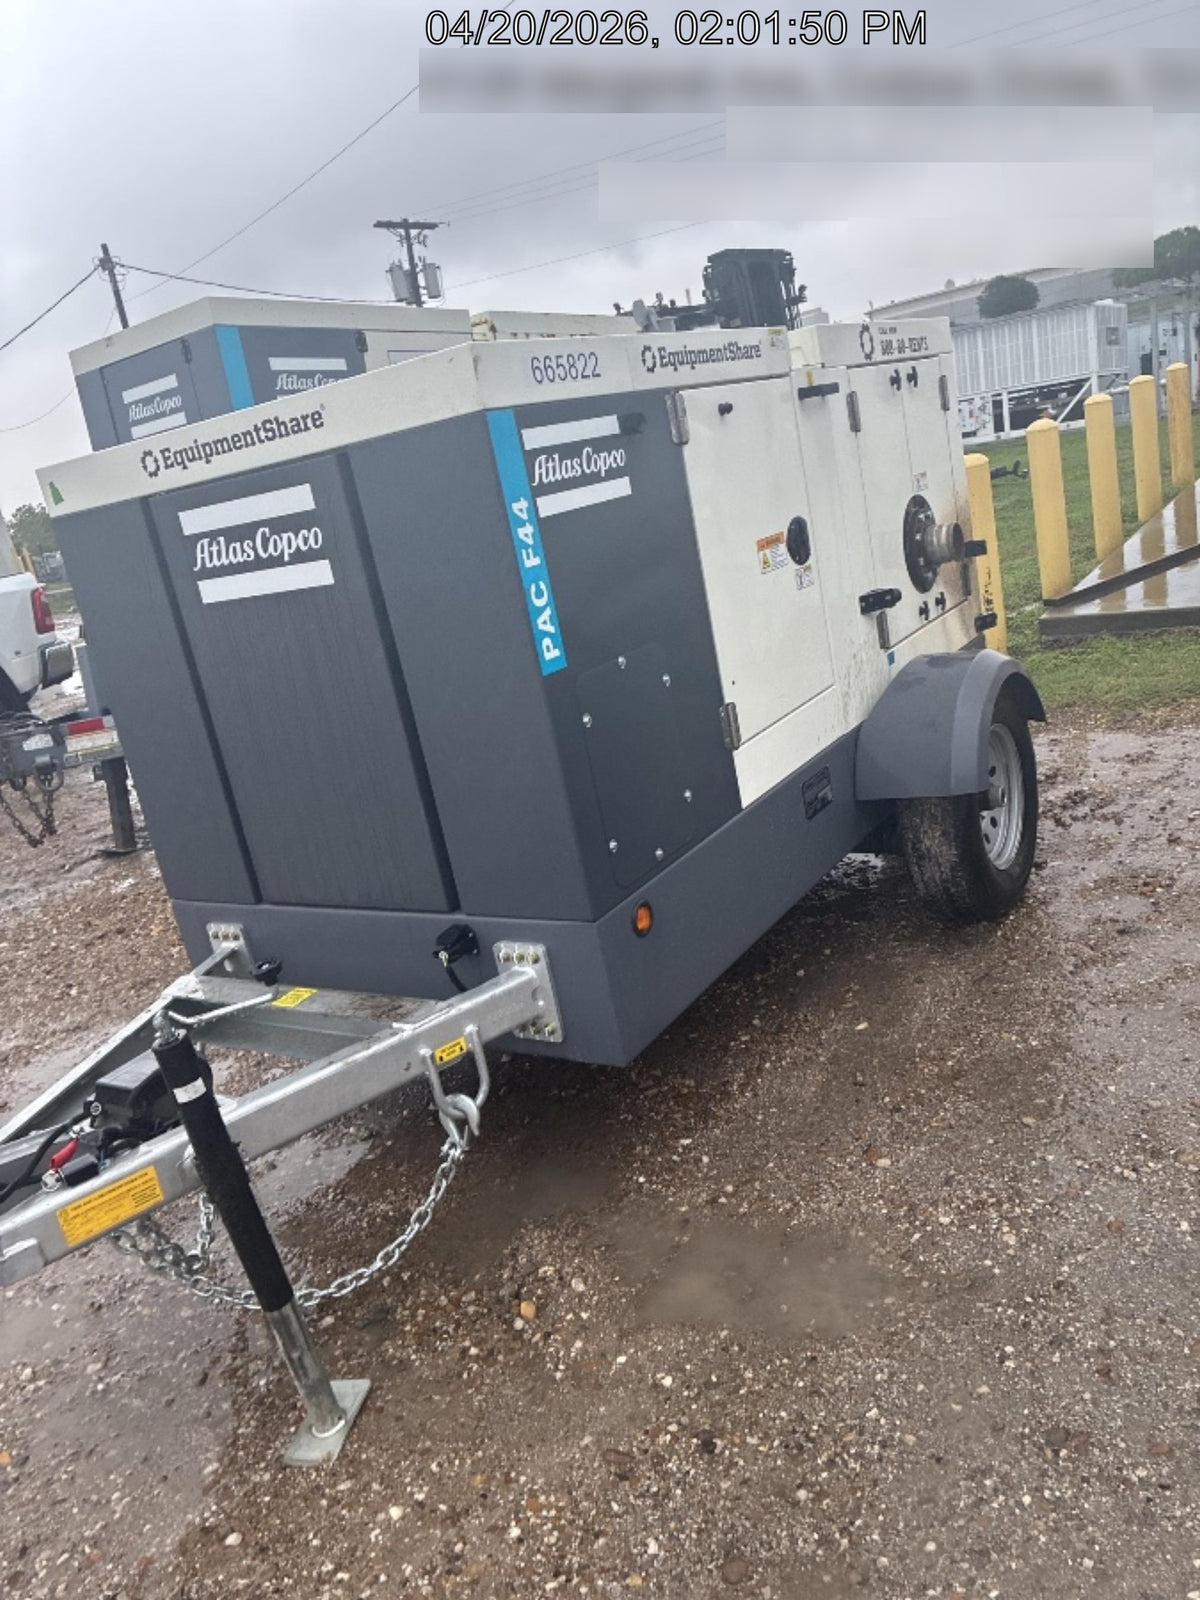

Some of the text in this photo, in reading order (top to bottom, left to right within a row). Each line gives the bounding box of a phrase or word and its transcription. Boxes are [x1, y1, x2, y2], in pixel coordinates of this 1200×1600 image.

[531, 352, 601, 384] 665822
[659, 341, 762, 372] EquipmentShare
[275, 373, 314, 391] Atlas
[128, 394, 183, 423] Atlas Copco
[160, 408, 325, 471] EquipmentShare
[532, 446, 627, 486] Atlas Copco
[193, 526, 323, 572] Atlas Copco
[511, 497, 561, 661] PAC F44
